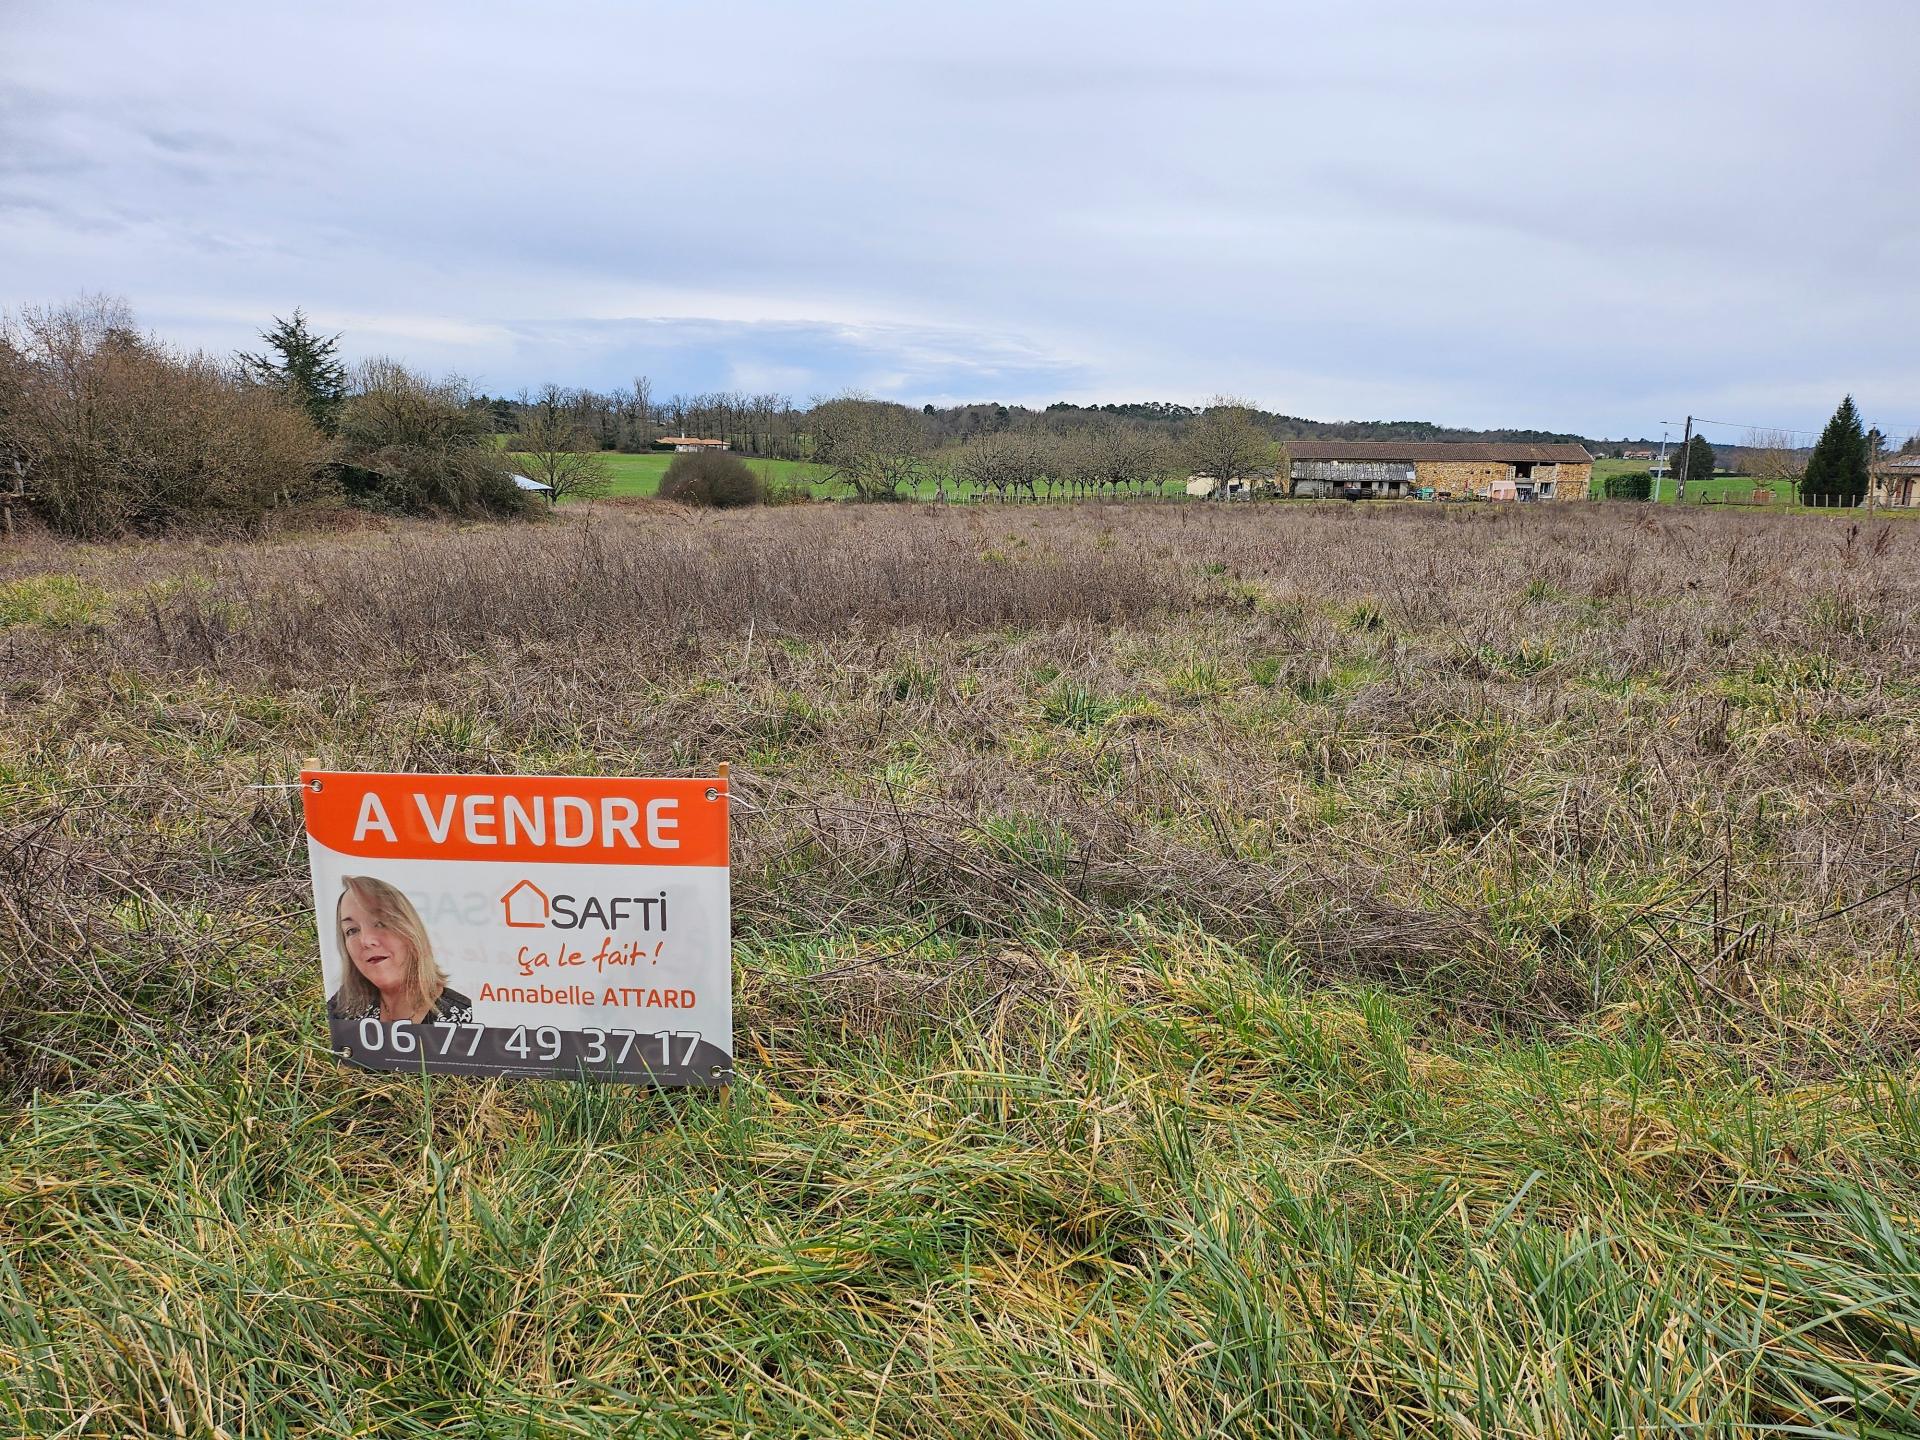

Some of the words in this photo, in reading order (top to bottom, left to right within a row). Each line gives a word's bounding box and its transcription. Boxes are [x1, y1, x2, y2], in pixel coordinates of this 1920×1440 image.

[353, 792, 398, 842] A
[413, 793, 679, 848] VENDRE
[592, 937, 646, 974] fait
[480, 983, 594, 1006] Annabelle
[602, 988, 696, 1009] ATTARD
[359, 1018, 415, 1053] 06
[434, 1022, 487, 1055] 77
[505, 1025, 561, 1060] 49
[583, 1028, 636, 1065] 37
[654, 1031, 701, 1066] 17
